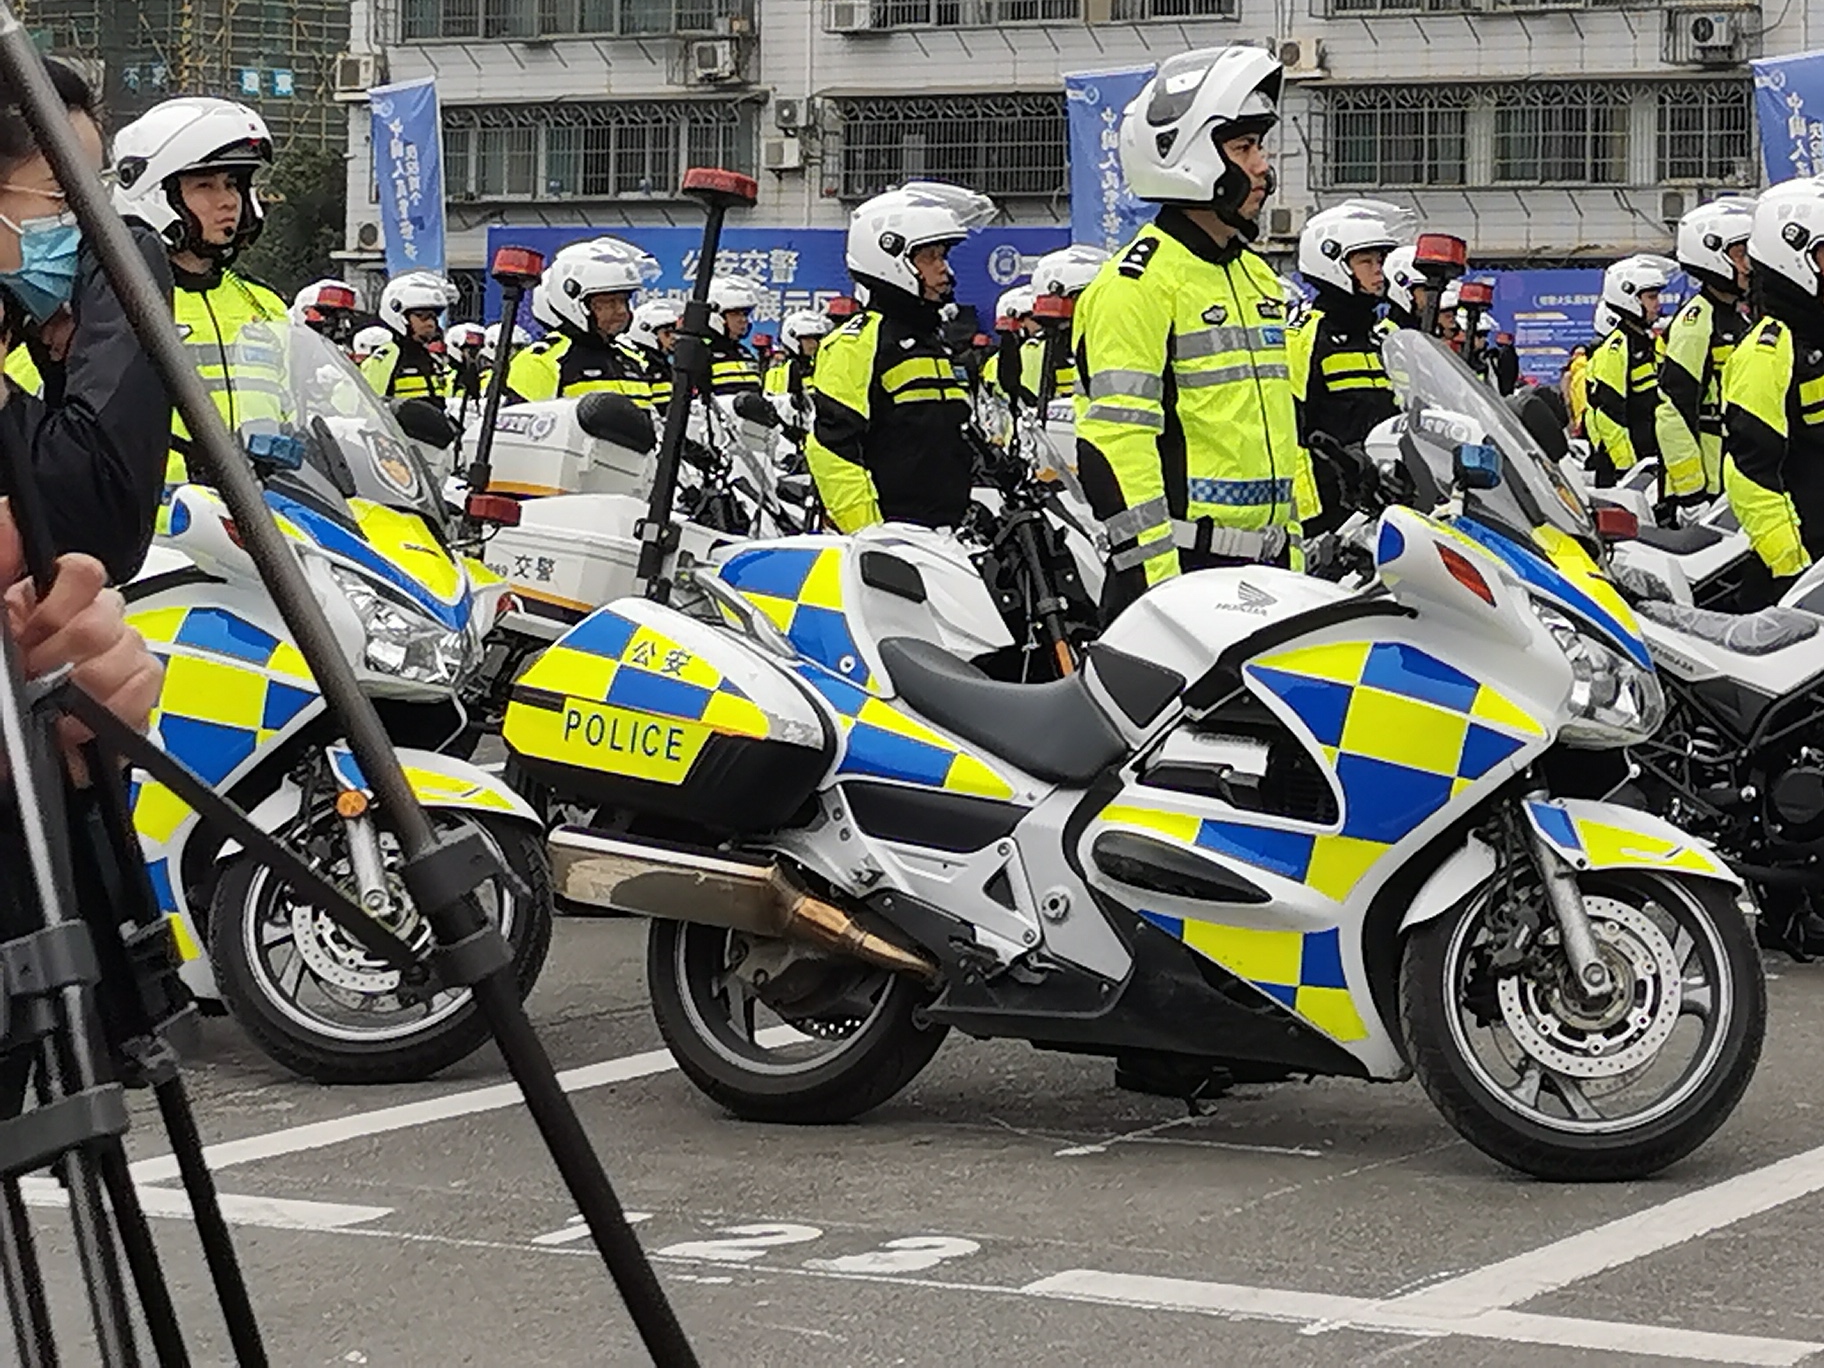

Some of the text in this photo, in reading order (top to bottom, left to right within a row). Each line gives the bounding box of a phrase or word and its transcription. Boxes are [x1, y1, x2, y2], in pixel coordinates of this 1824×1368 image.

[513, 553, 556, 583] 交警
[631, 639, 692, 679] 公安
[563, 707, 687, 763] POLICE
